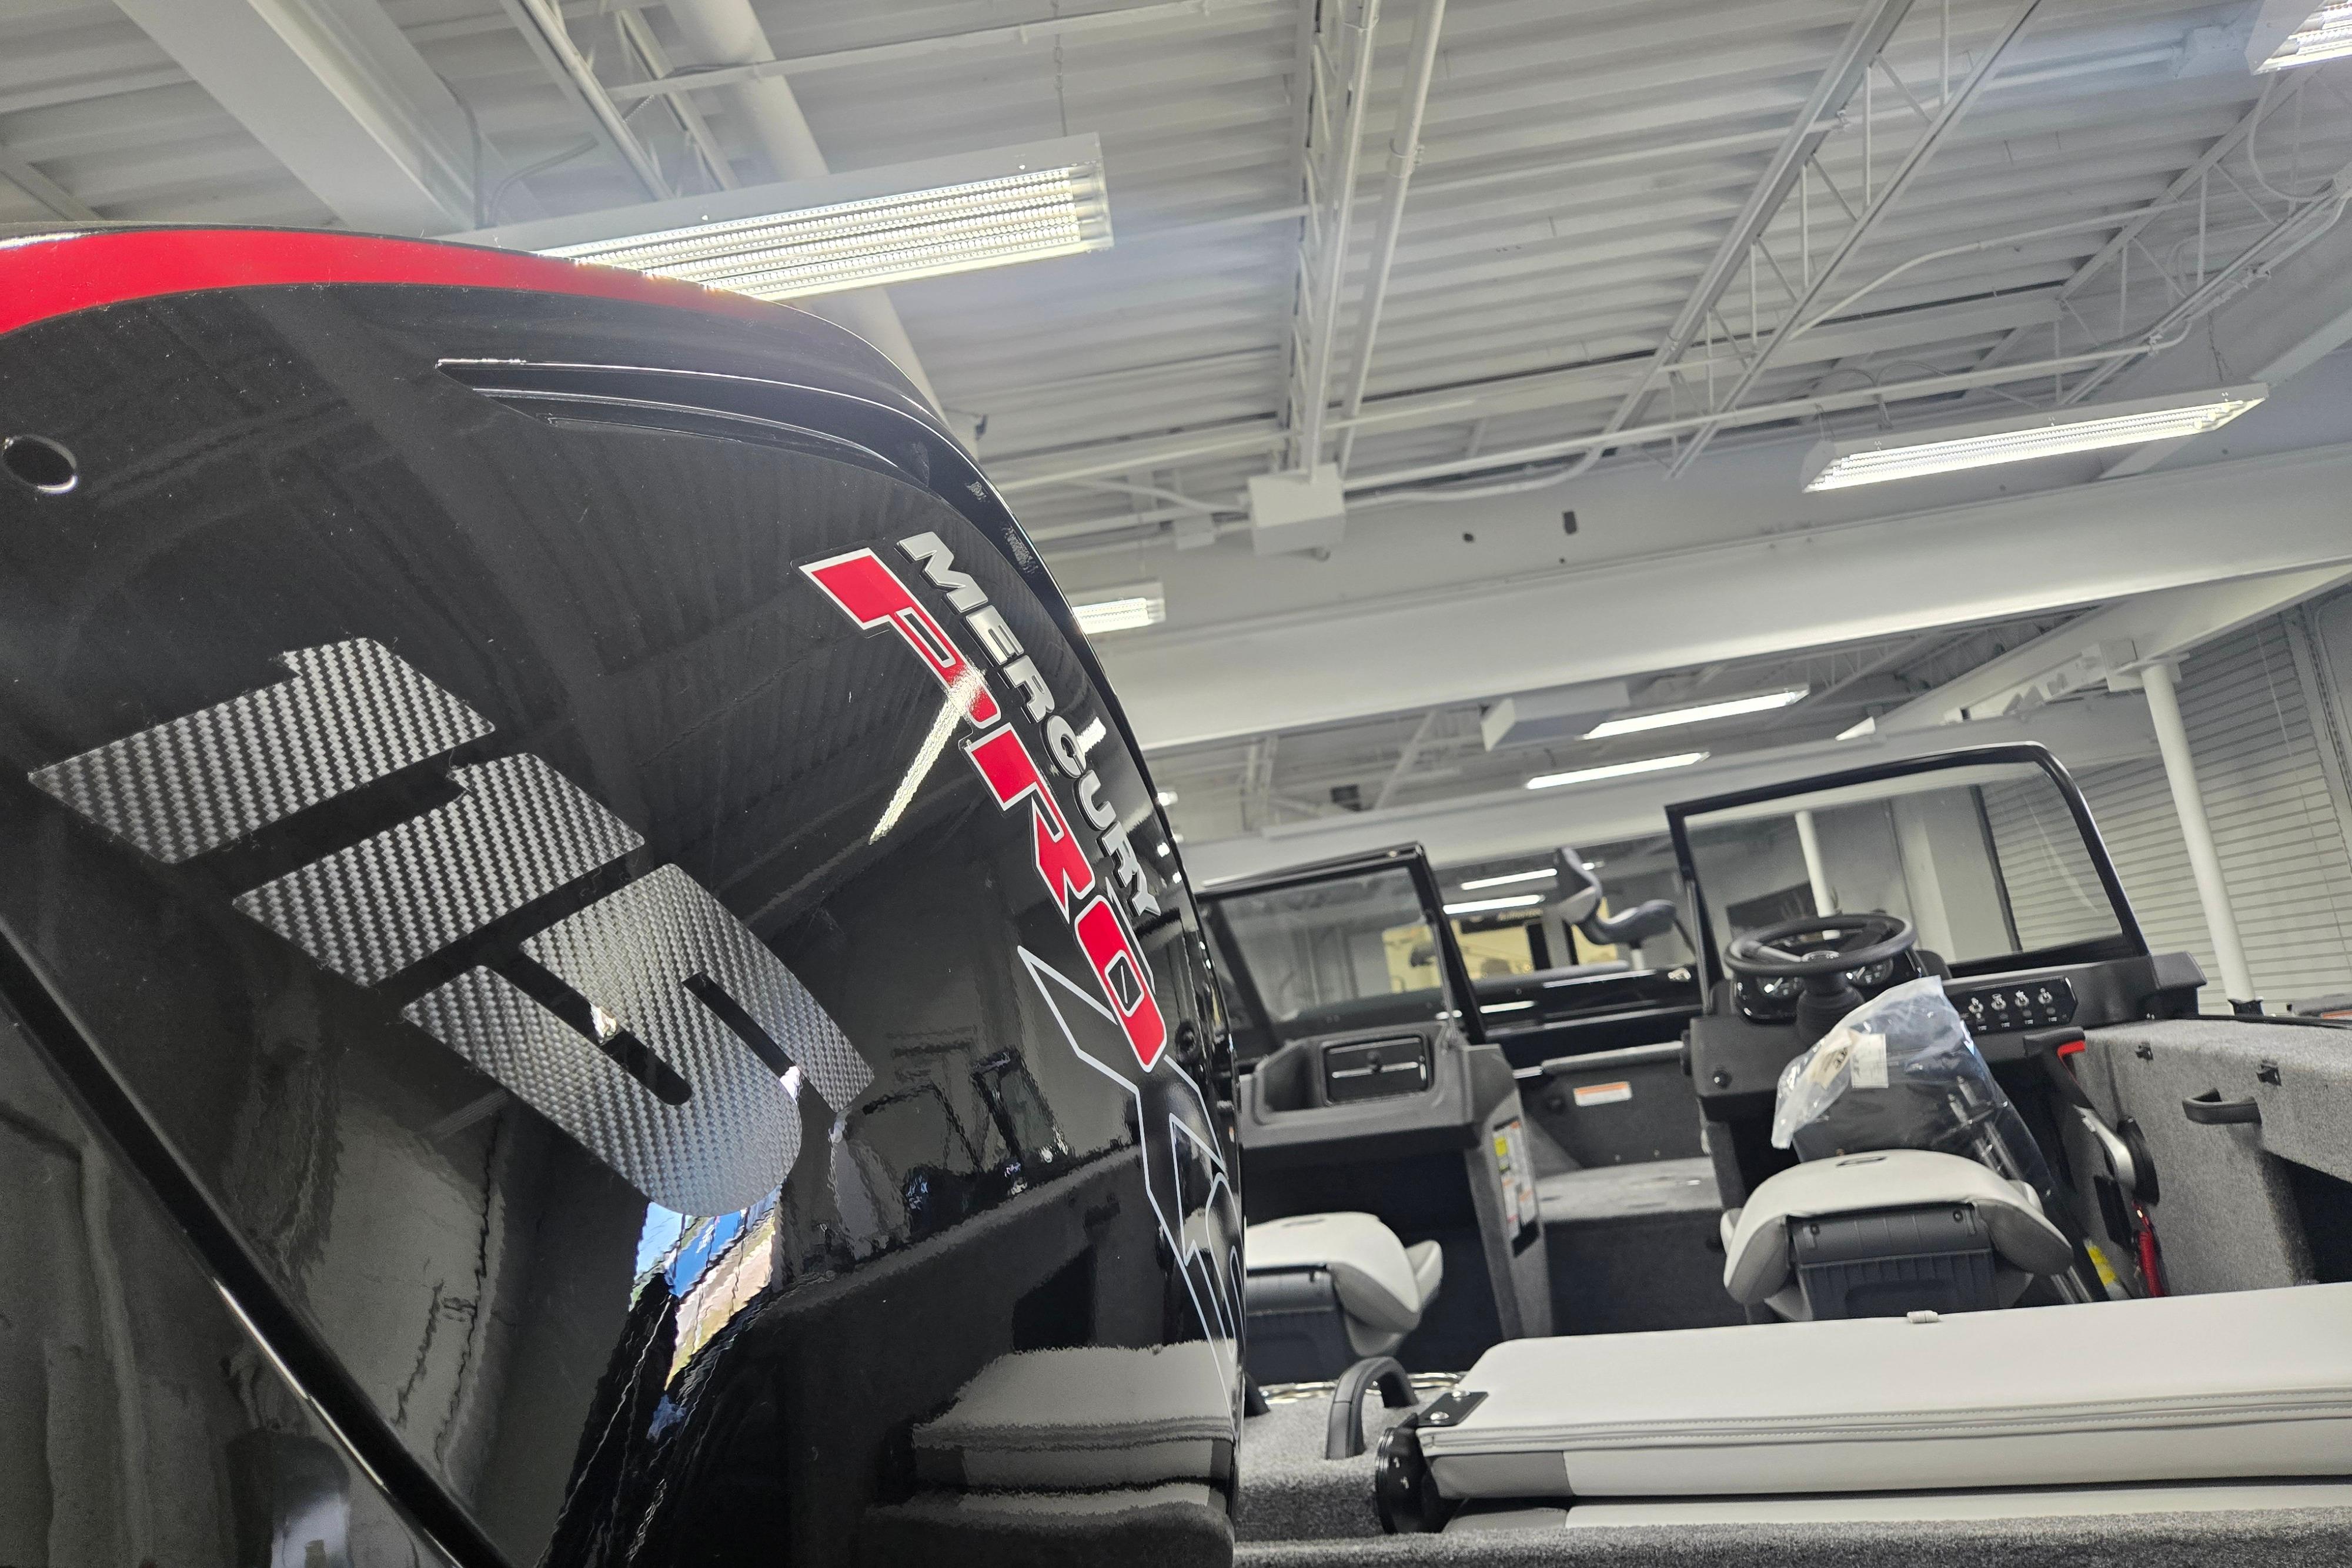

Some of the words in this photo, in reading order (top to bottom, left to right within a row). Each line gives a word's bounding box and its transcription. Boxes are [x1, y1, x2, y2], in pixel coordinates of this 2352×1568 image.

[27, 637, 875, 1217] 115
[799, 547, 1168, 1072] PRO
[896, 531, 1161, 916] MERCURY
